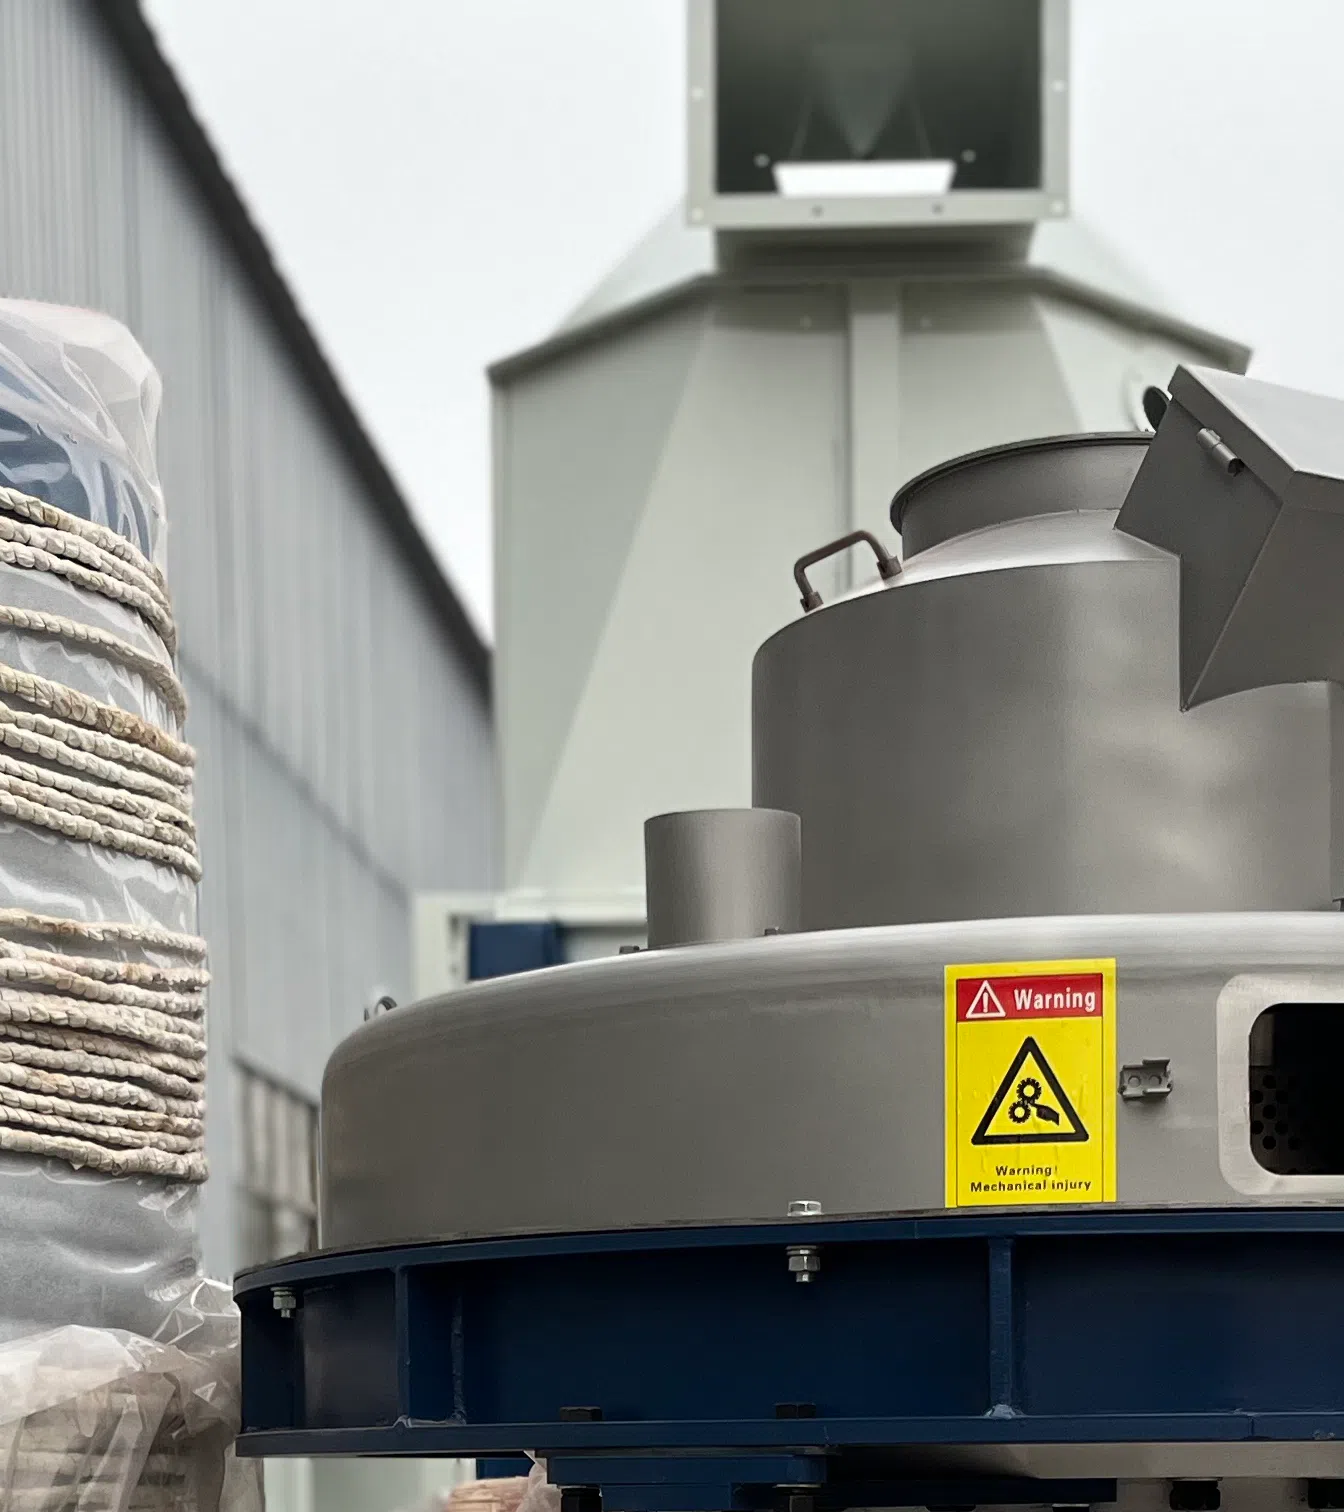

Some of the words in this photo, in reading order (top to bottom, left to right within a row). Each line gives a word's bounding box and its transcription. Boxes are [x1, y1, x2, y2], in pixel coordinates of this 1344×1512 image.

[1013, 987, 1096, 1012] Warning
[970, 1180, 1047, 1193] Mechanical
[1051, 1179, 1092, 1192] injury
